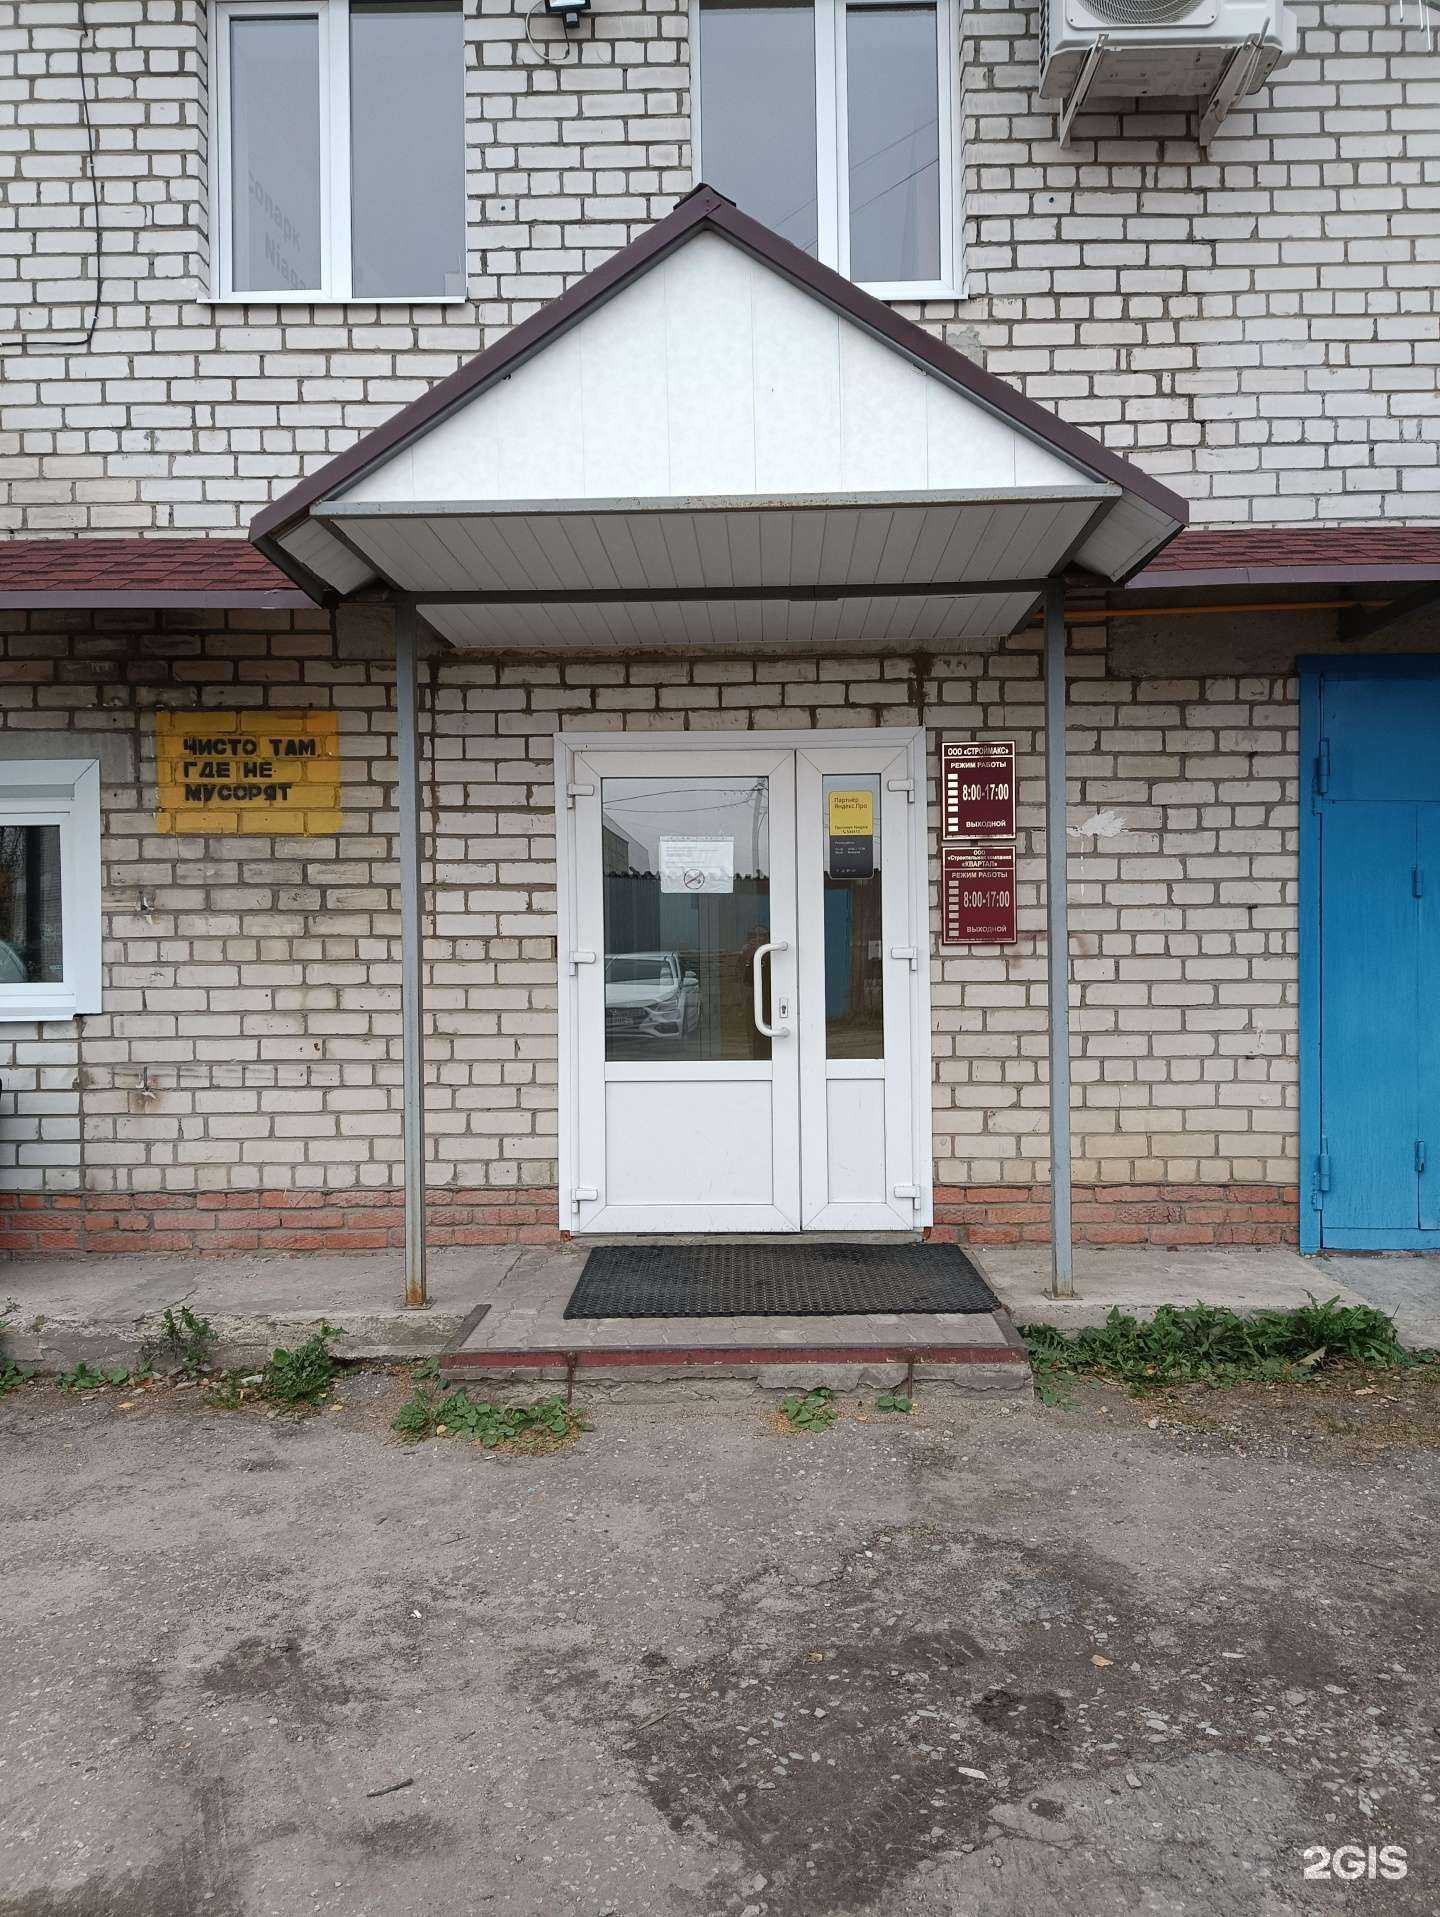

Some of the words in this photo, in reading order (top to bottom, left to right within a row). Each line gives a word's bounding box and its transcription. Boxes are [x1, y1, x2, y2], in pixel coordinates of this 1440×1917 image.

[183, 736, 257, 756] ЧИСТО
[269, 738, 316, 756] ТАМ
[947, 747, 962, 755] ООО
[963, 745, 1009, 755] «СТРОЙМАКС»
[183, 761, 230, 778] ГДЕ
[243, 761, 273, 778] НЕ
[184, 783, 292, 803] МУСОРЯТ
[962, 783, 1009, 801] 8:00-17:00
[965, 819, 1006, 828] ВЫХОДНОЙ
[963, 890, 1010, 908] 8:00-17:00
[966, 924, 1007, 933] ВЫХОДНОЙ
